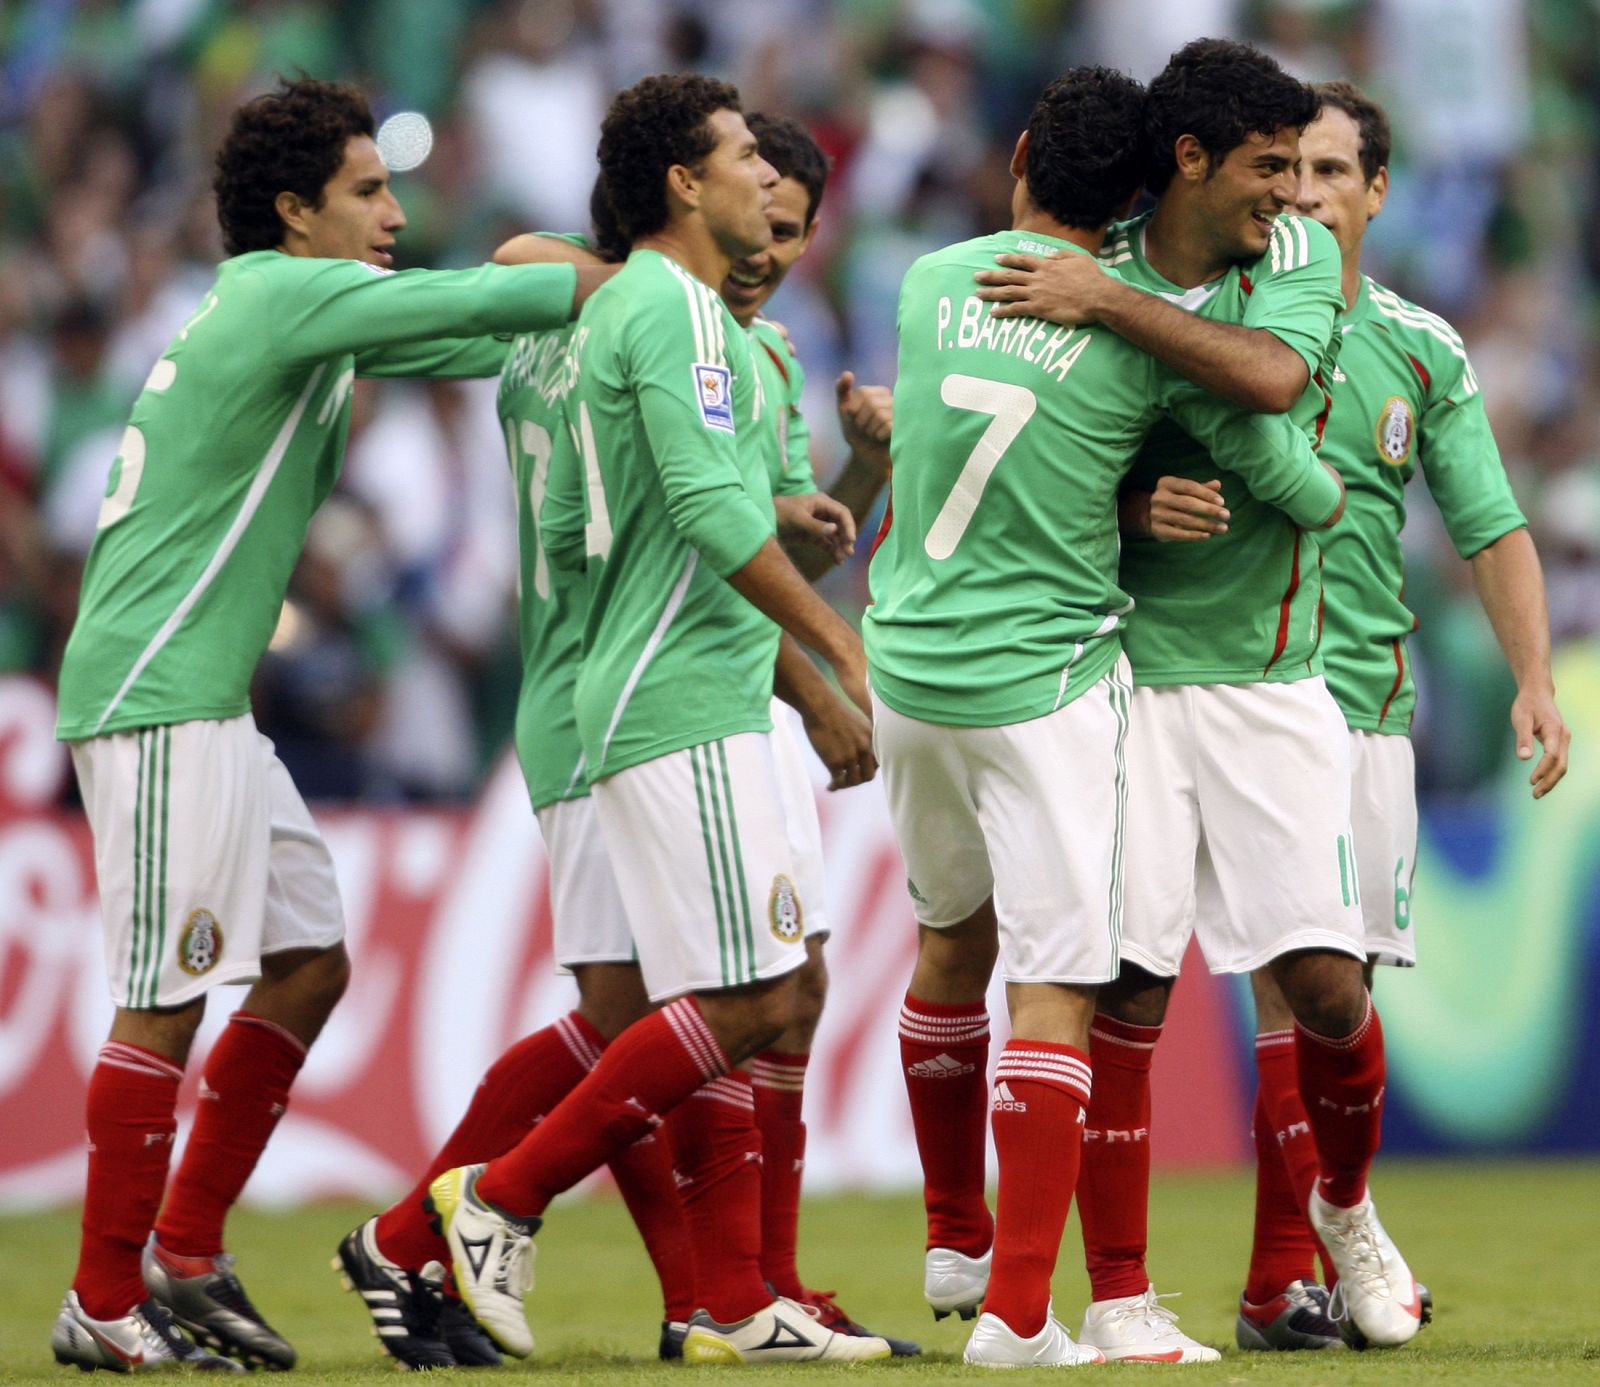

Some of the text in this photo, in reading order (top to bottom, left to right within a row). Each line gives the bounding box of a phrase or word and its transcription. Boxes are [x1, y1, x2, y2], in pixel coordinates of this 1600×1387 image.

[924, 373, 1038, 561] 7
[1394, 855, 1410, 930] 6
[907, 1062, 976, 1079] adidas
[1082, 1127, 1149, 1143] FMF
